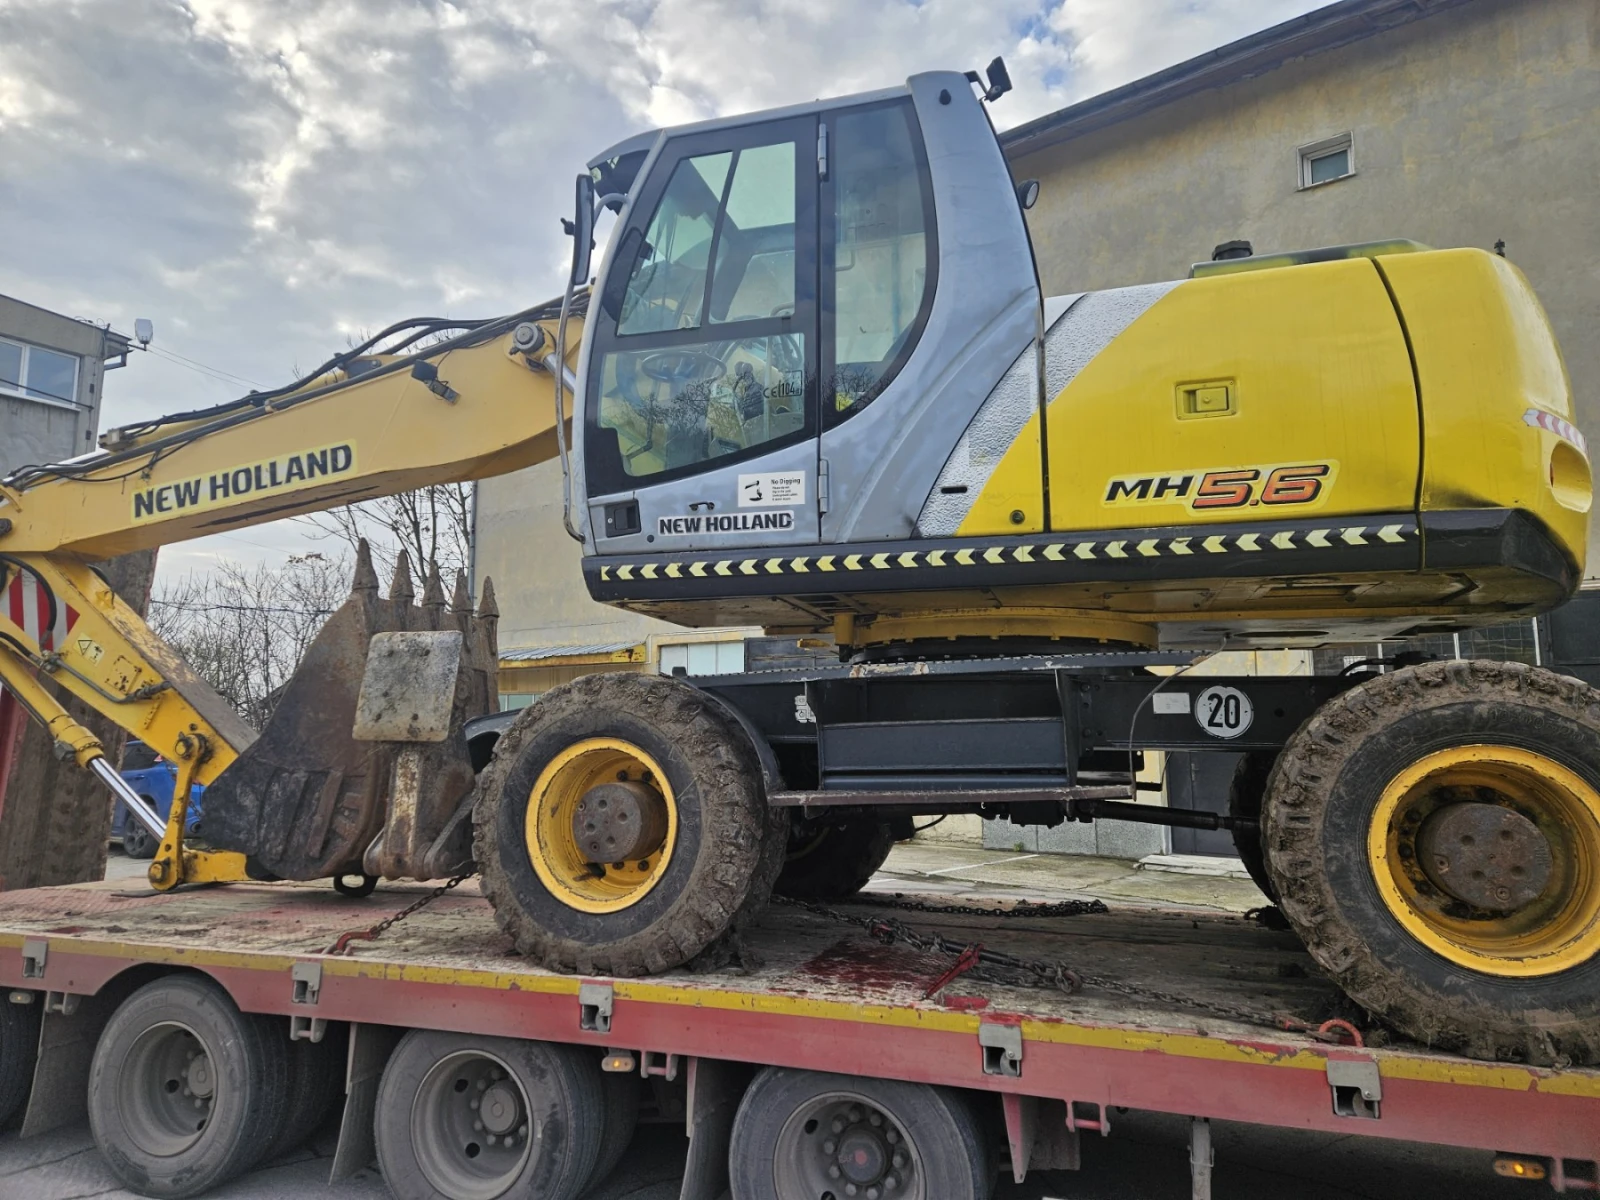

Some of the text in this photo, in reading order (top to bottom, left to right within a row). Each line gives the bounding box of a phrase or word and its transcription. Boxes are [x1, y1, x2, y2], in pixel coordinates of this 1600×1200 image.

[134, 444, 352, 518] NEW HOLLAND
[660, 513, 792, 535] NEW HOLLAND
[1207, 693, 1241, 729] 20
